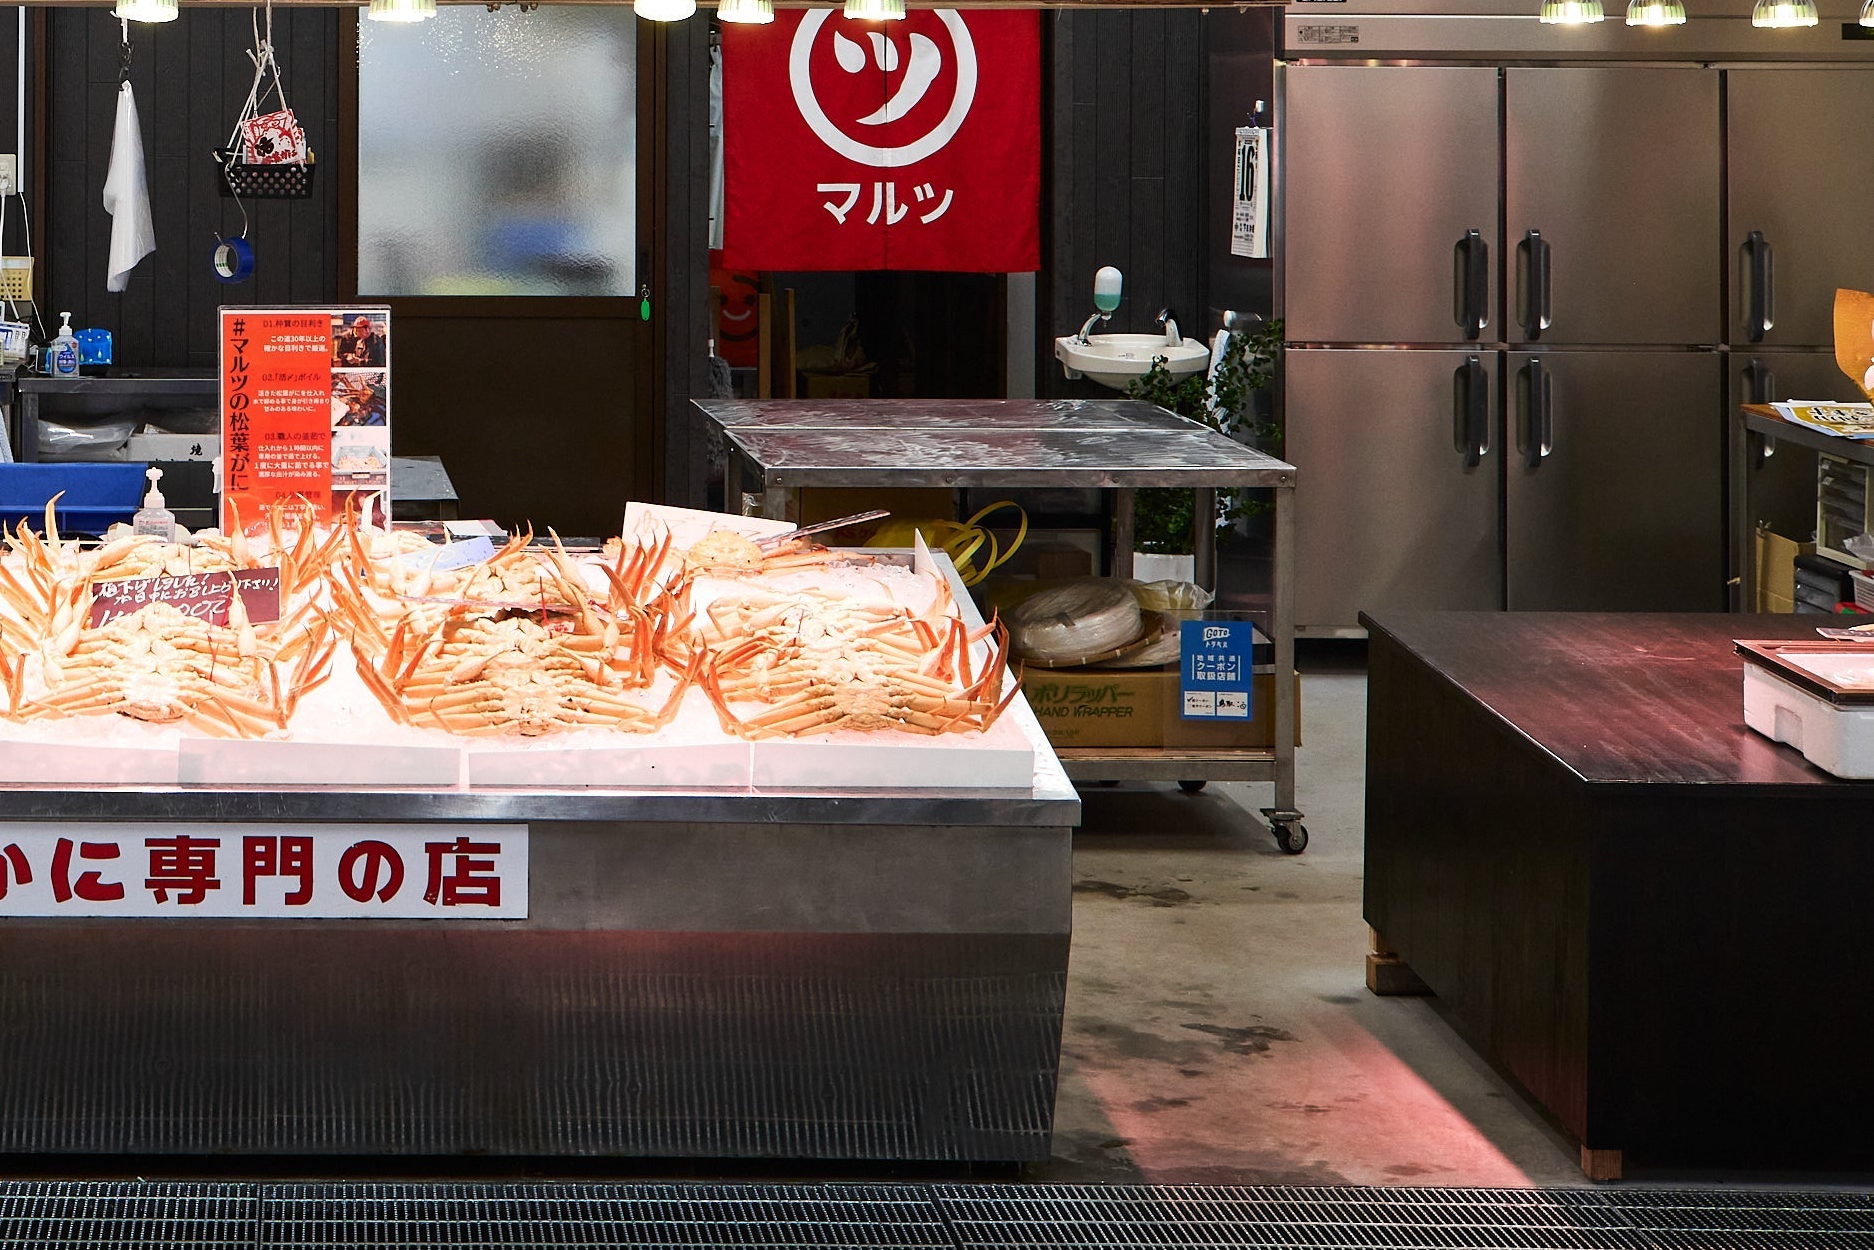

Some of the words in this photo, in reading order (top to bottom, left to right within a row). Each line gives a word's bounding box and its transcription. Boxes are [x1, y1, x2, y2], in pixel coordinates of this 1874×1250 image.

[1239, 144, 1255, 202] 16
[816, 181, 955, 226] マルツ
[1197, 661, 1236, 671] クーポン
[1031, 682, 1135, 705] ポリラッパー
[1035, 706, 1070, 718] HAND
[1073, 704, 1134, 718] WRAPPER
